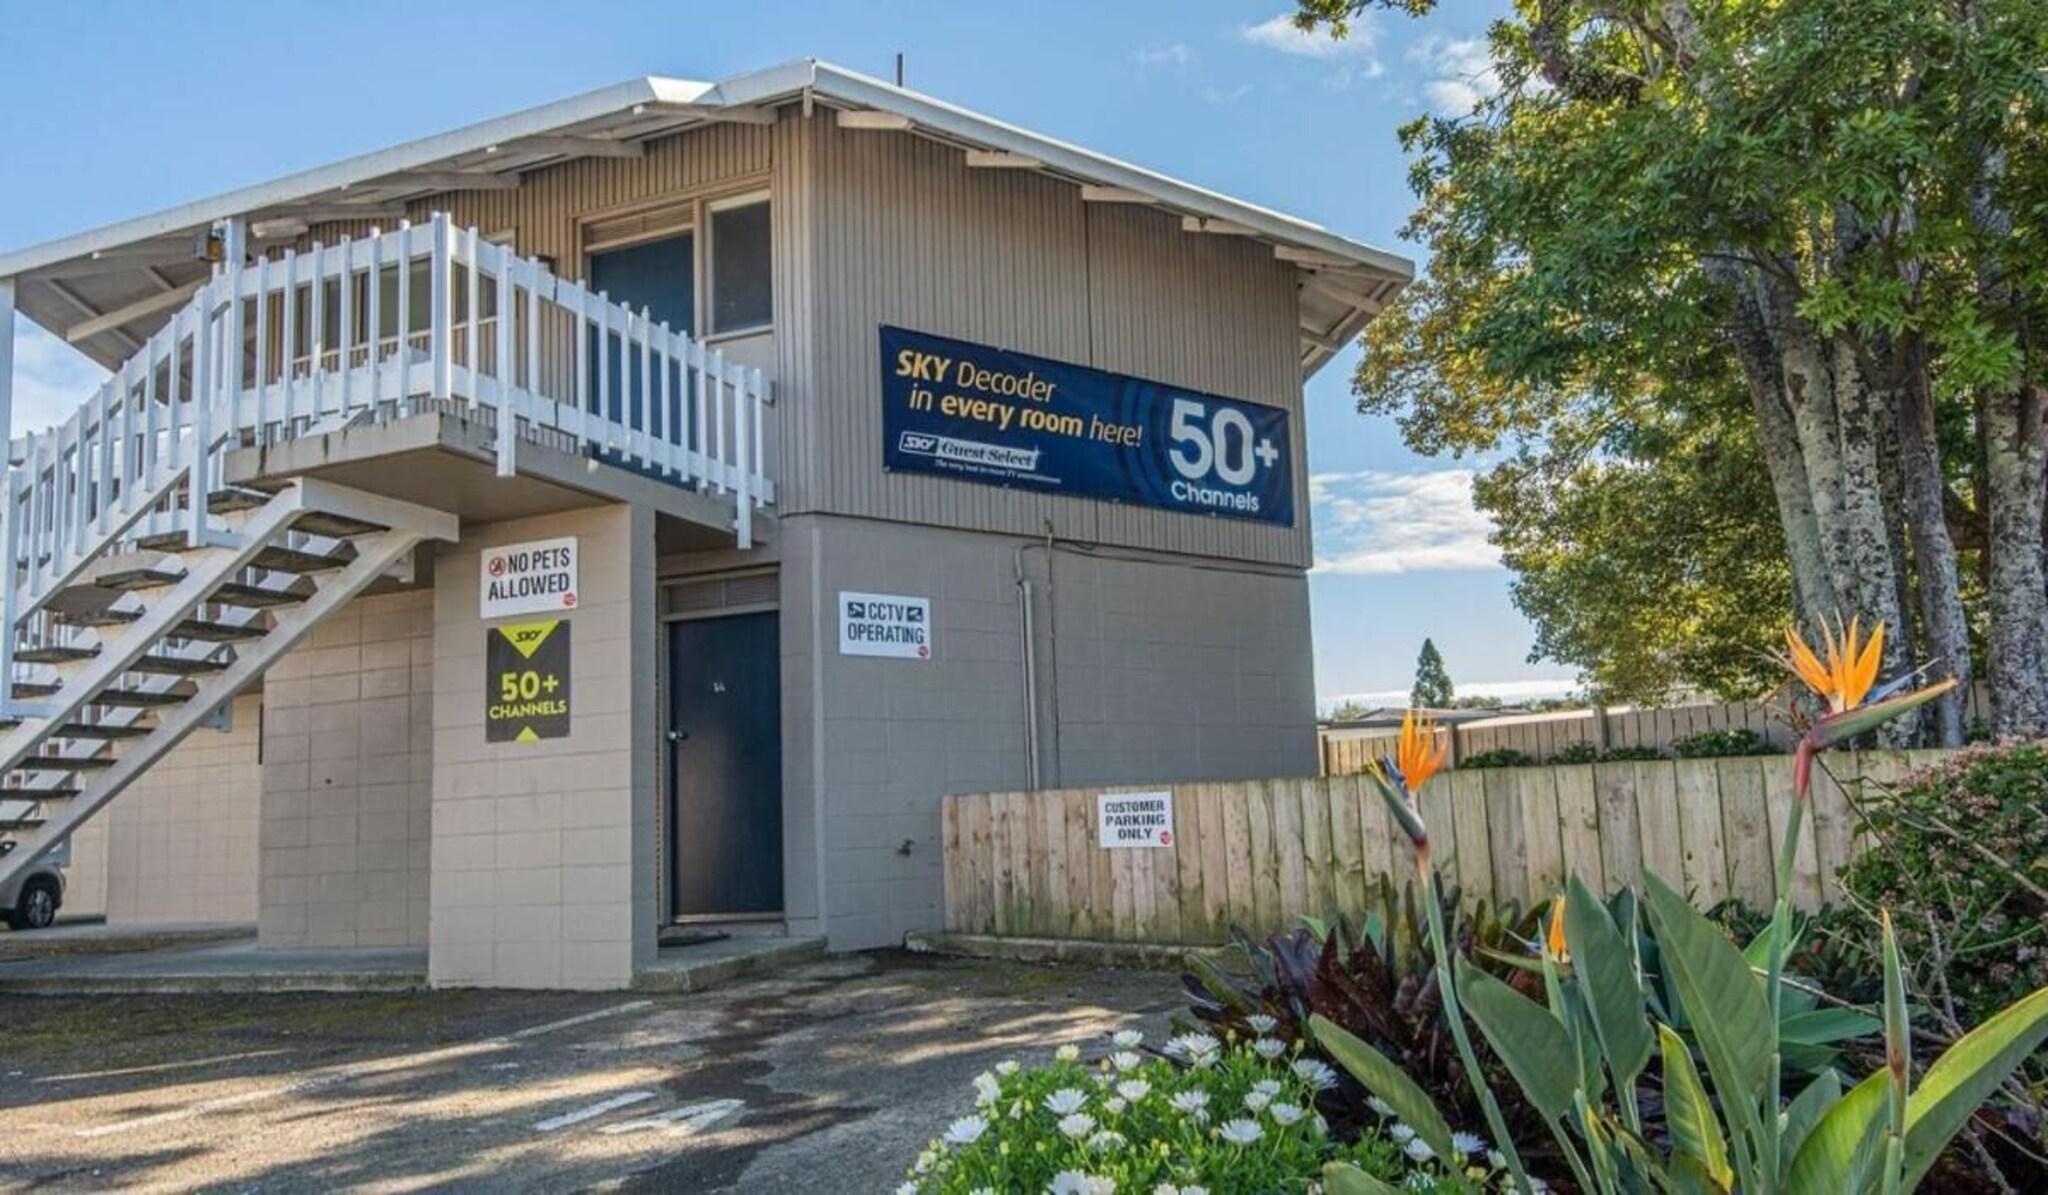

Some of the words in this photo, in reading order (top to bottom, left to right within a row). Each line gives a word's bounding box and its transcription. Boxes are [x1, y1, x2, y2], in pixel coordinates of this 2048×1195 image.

[897, 349, 952, 382] SKY
[957, 361, 1056, 402] Decoder
[909, 384, 932, 411] in
[940, 395, 1014, 431] every
[1019, 411, 1084, 437] room
[1090, 415, 1142, 447] here!
[942, 441, 985, 460] Guest
[988, 449, 1032, 466] Select
[1169, 398, 1279, 486] 50+
[1170, 480, 1260, 512] Channels
[508, 552, 528, 574] NO
[532, 547, 570, 569] PETS
[488, 572, 570, 601] ALLOWED
[868, 602, 905, 621] CCTV
[848, 622, 924, 644] OPERATING
[501, 670, 559, 702] 50+
[489, 700, 567, 719] CHANNELS
[1105, 800, 1165, 813] CUSTOMER
[1105, 813, 1165, 826] PARKING
[1117, 827, 1152, 840] ONLY
